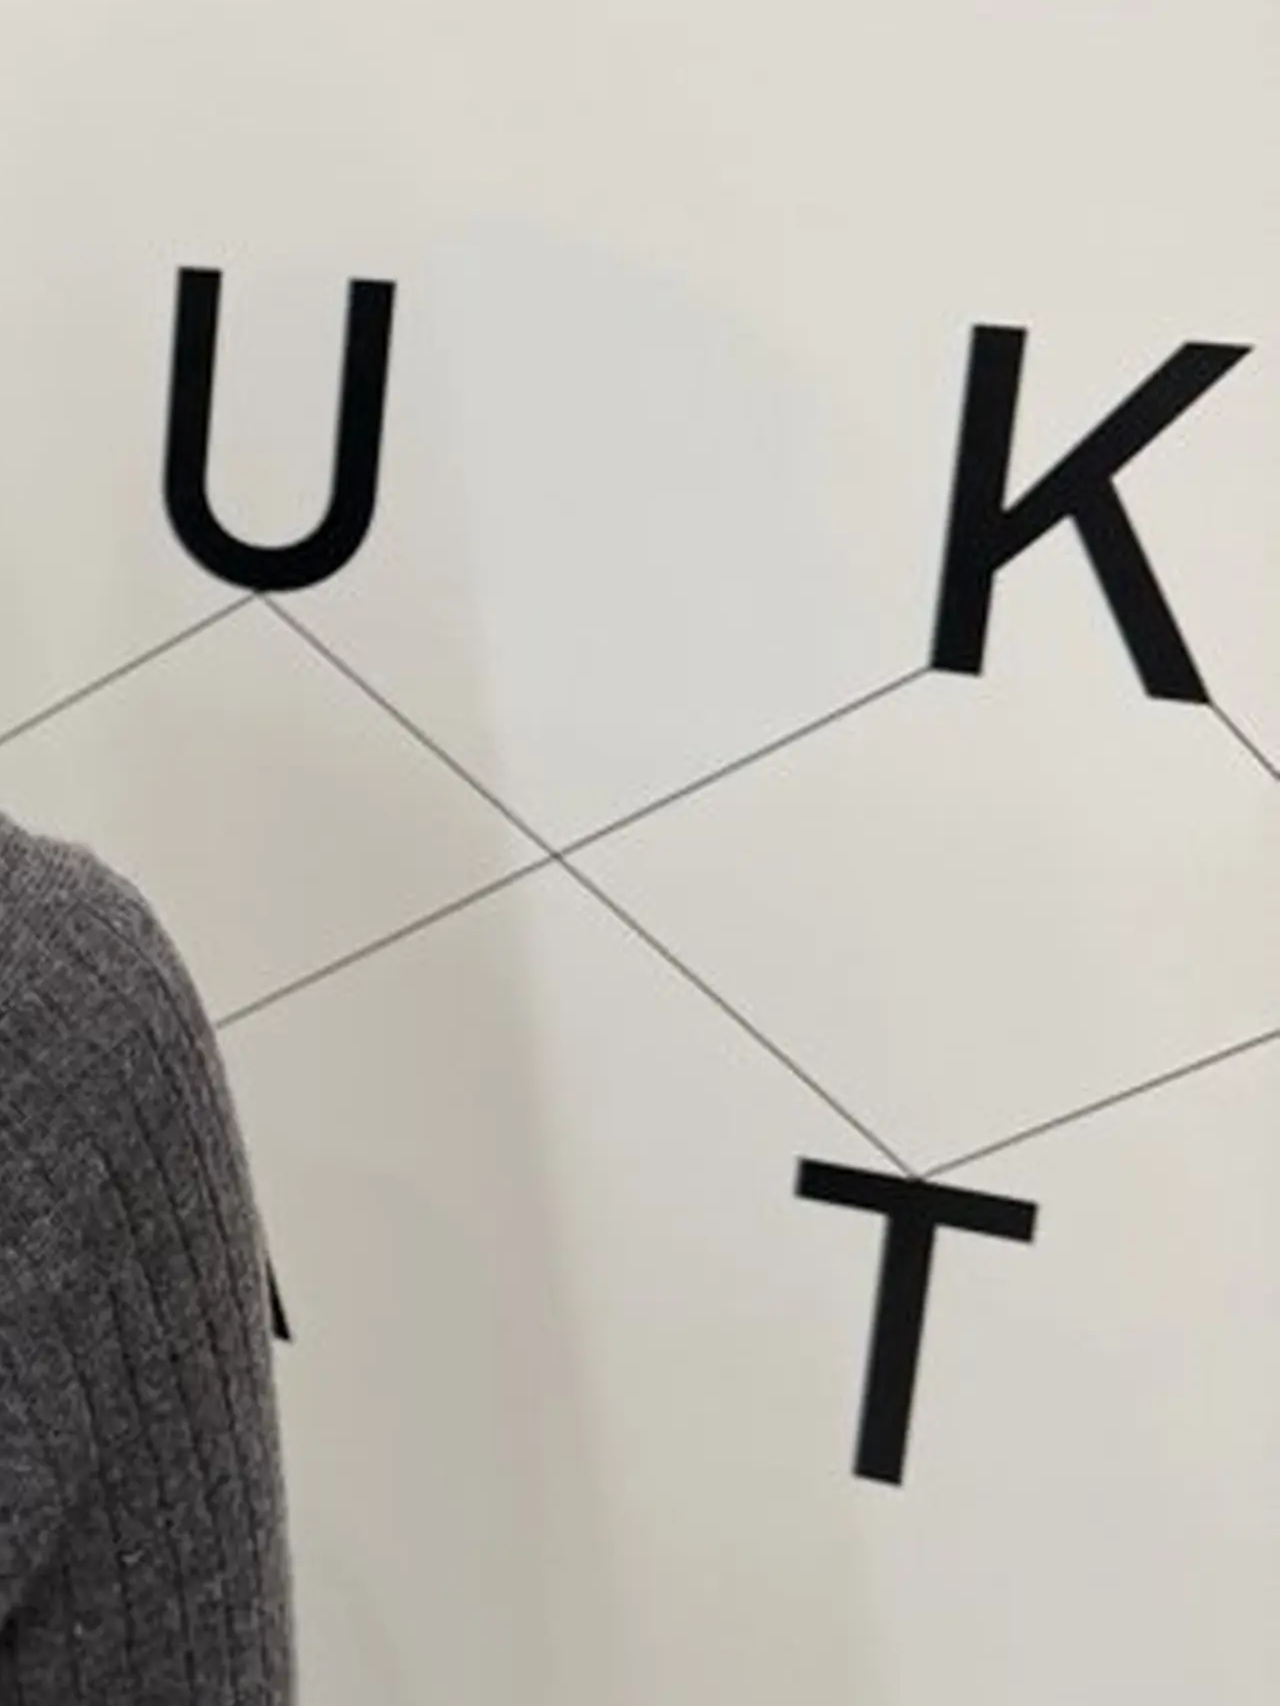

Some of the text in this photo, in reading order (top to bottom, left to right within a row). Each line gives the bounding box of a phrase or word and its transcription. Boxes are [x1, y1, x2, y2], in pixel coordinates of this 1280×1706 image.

[163, 266, 397, 594] U
[929, 324, 1253, 706] K
[795, 1158, 1038, 1487] T
